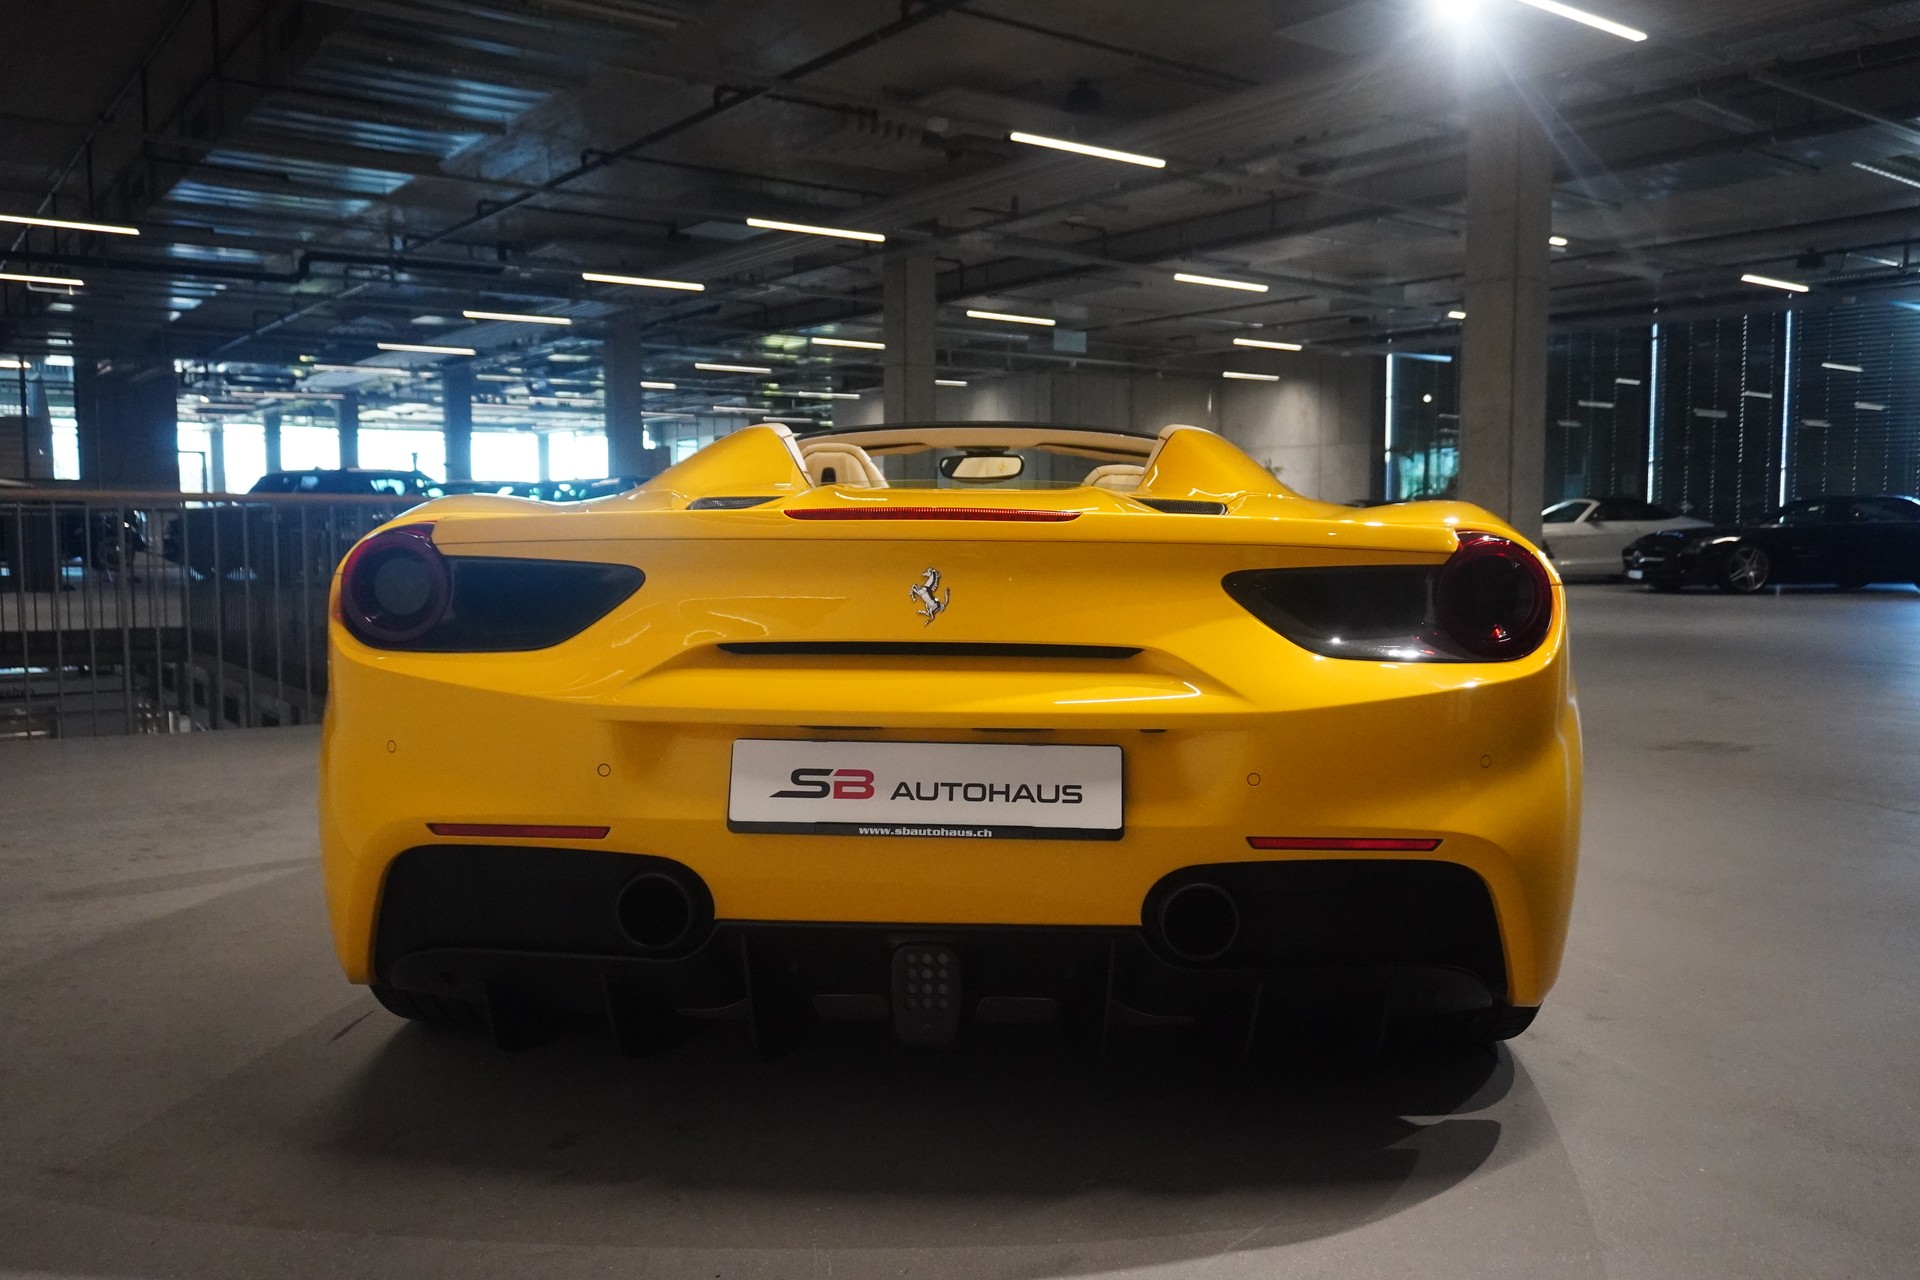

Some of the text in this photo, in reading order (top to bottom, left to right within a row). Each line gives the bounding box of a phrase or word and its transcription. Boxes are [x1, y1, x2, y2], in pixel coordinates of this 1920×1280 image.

[769, 768, 1083, 804] SB AUTOHAUS
[858, 826, 993, 838] www.sbautohaus.ch
